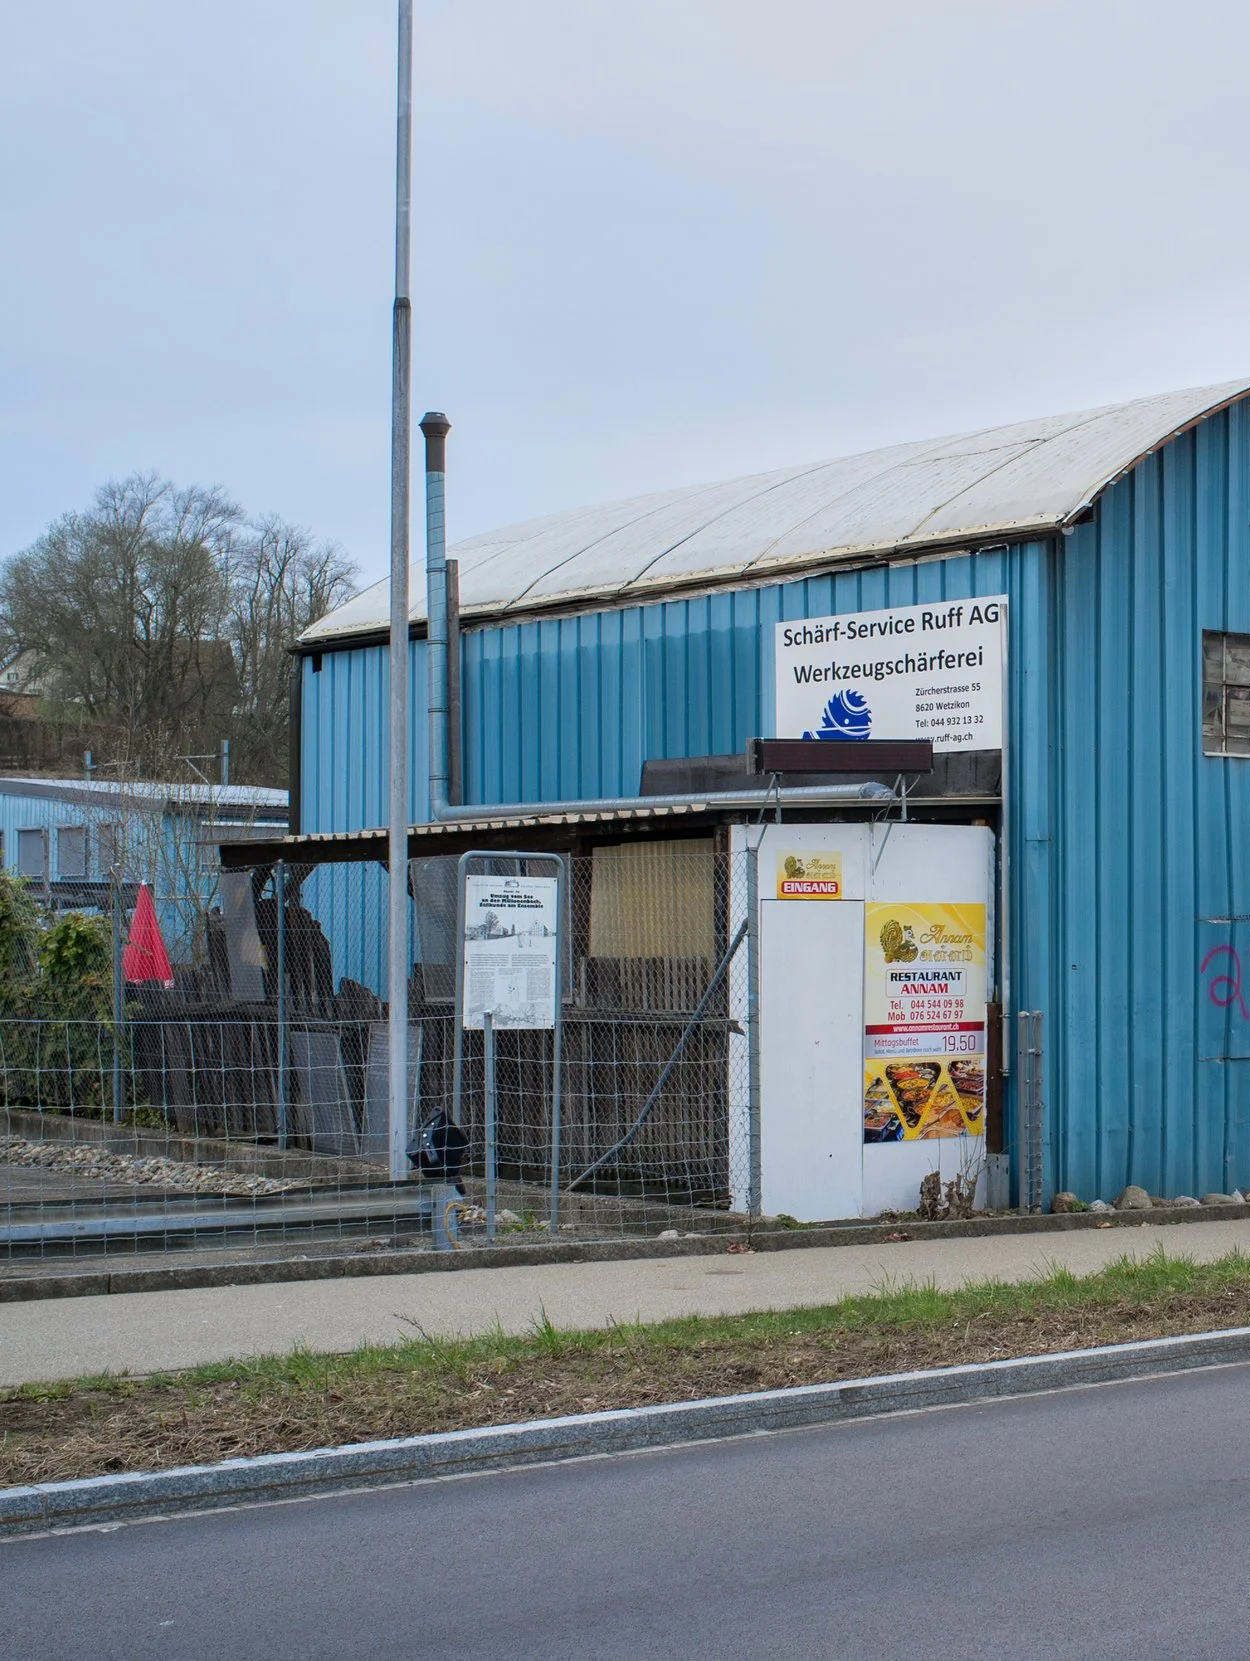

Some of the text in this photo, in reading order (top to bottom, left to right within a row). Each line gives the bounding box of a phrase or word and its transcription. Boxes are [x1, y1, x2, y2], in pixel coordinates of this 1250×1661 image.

[784, 603, 1000, 647] Schärf-Service Ruff AG
[794, 646, 983, 684] Werkzeugschärferei
[915, 682, 982, 697] Zürcherstrasse 55
[915, 700, 970, 712] 8620 Wetzikon
[915, 714, 984, 728] Tel: 044 932 13 32
[806, 858, 836, 869] Annam
[783, 882, 837, 893] EINGANG
[920, 924, 973, 944] Annam
[890, 972, 962, 982] RESTAURANT
[900, 983, 949, 995] ANNAM
[890, 999, 965, 1010] Tel. 044 544 09 98
[888, 1009, 963, 1021] Mob 076 524 67 97
[874, 1035, 976, 1052] Mittagsbuffet 19.50
